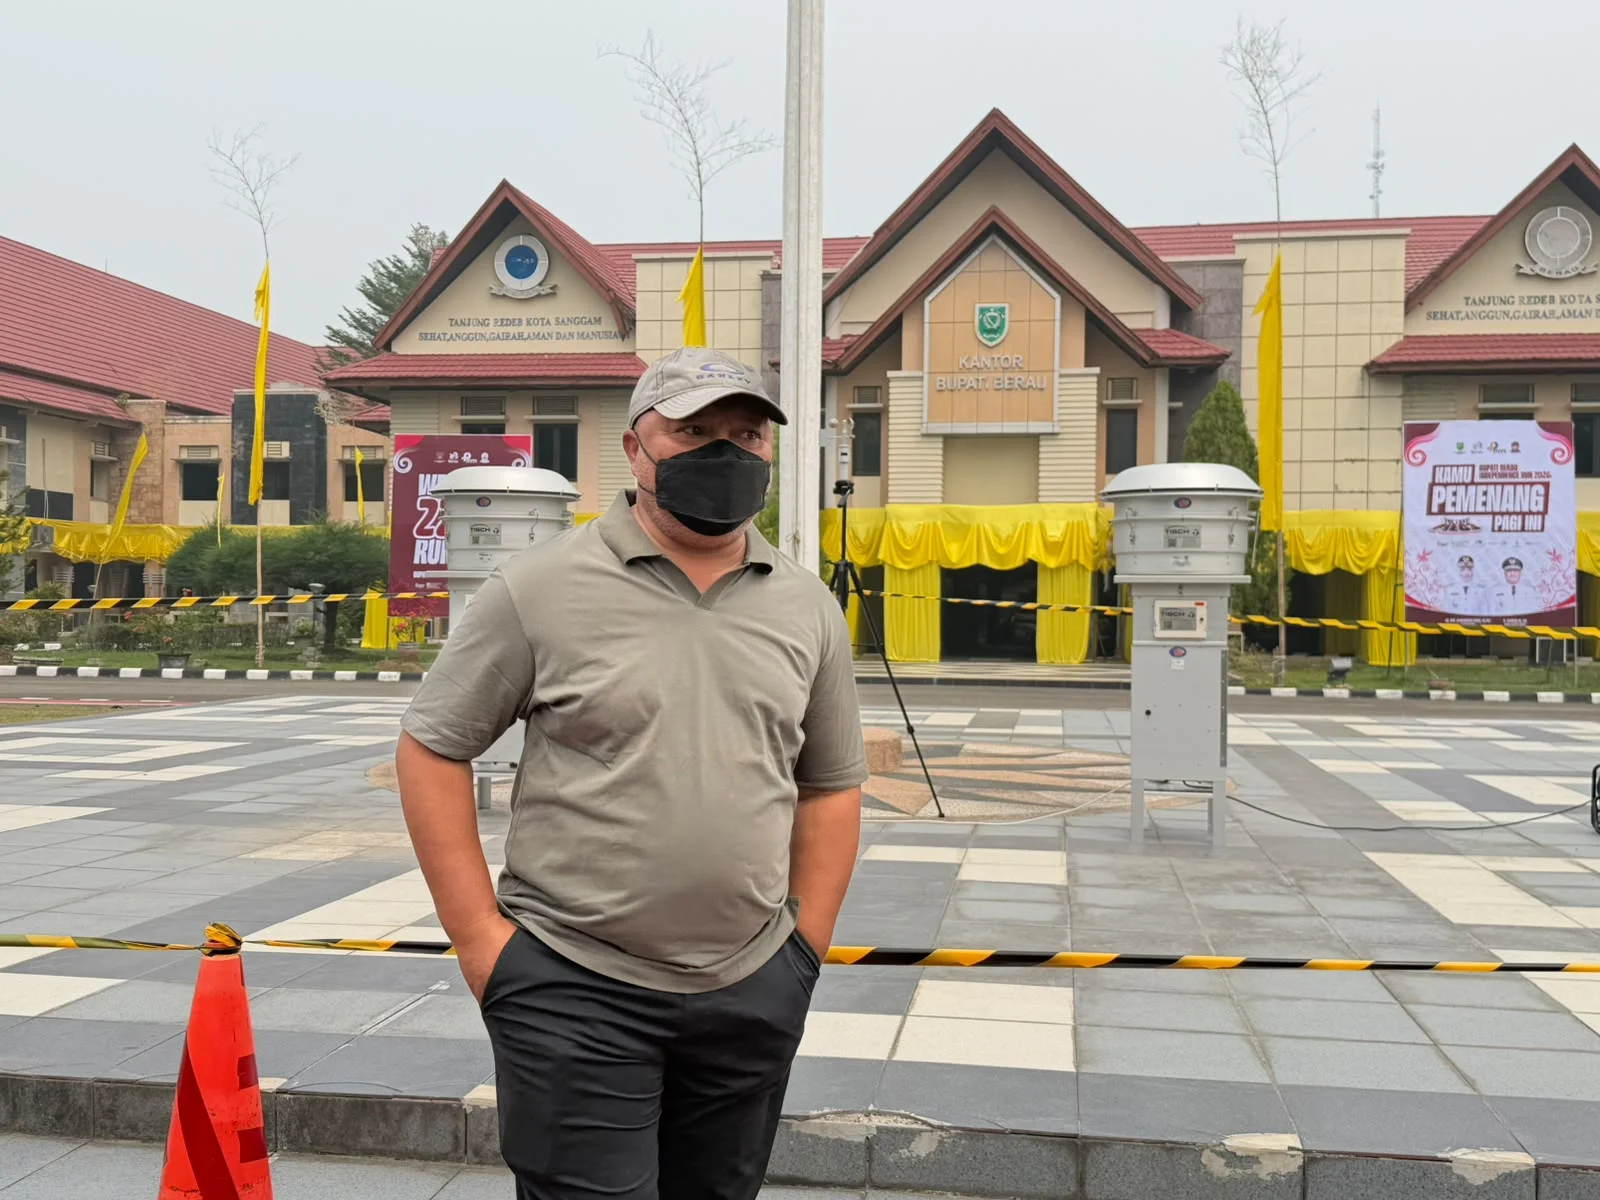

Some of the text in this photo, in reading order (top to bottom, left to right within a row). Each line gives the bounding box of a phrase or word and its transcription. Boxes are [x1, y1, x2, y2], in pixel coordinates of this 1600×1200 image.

[1464, 296, 1515, 306] TANJUNG
[1518, 295, 1556, 306] REDEB
[1559, 294, 1593, 305] KOTA
[448, 316, 602, 327] TANJUNG REDEB KOTA SANGGAM
[555, 331, 575, 341] DAN
[959, 355, 1024, 370] KANTOR
[936, 375, 1047, 392] BUPATI BERAU
[1434, 465, 1473, 484] KAMU
[1431, 484, 1545, 513] PEMENANG
[1494, 515, 1542, 531] PAGI INI
